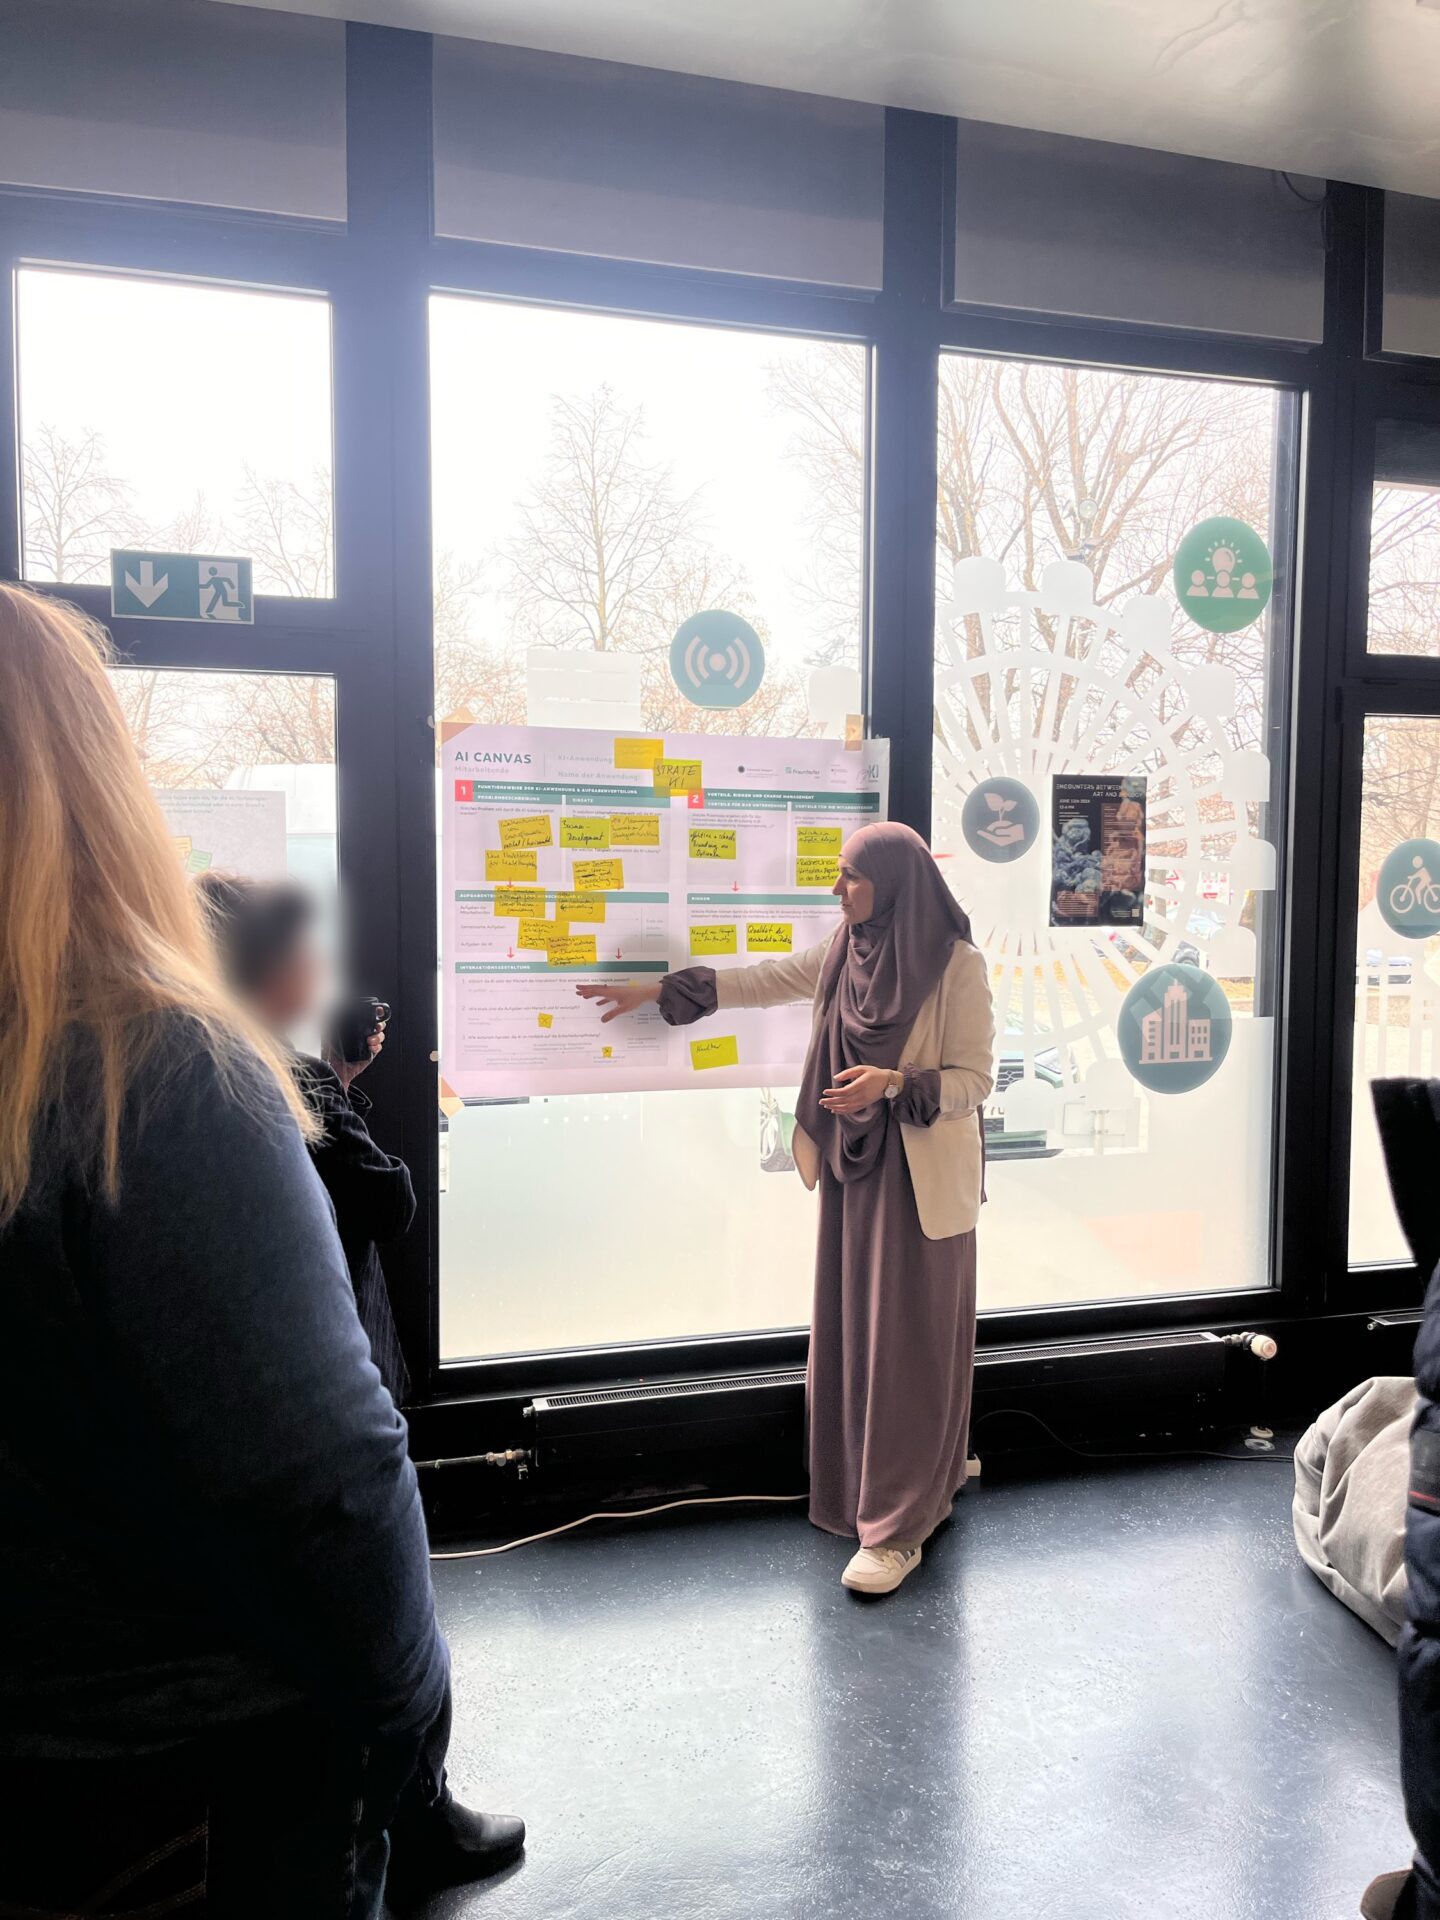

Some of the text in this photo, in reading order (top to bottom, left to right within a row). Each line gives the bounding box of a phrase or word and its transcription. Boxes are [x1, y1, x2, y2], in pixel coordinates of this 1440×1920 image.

[455, 751, 532, 764] AI CANVAS
[455, 765, 510, 774] Mitarbeitende
[656, 764, 696, 776] STRATE
[596, 772, 641, 782] Anwendung:
[461, 786, 467, 796] 1
[692, 795, 700, 804] 2
